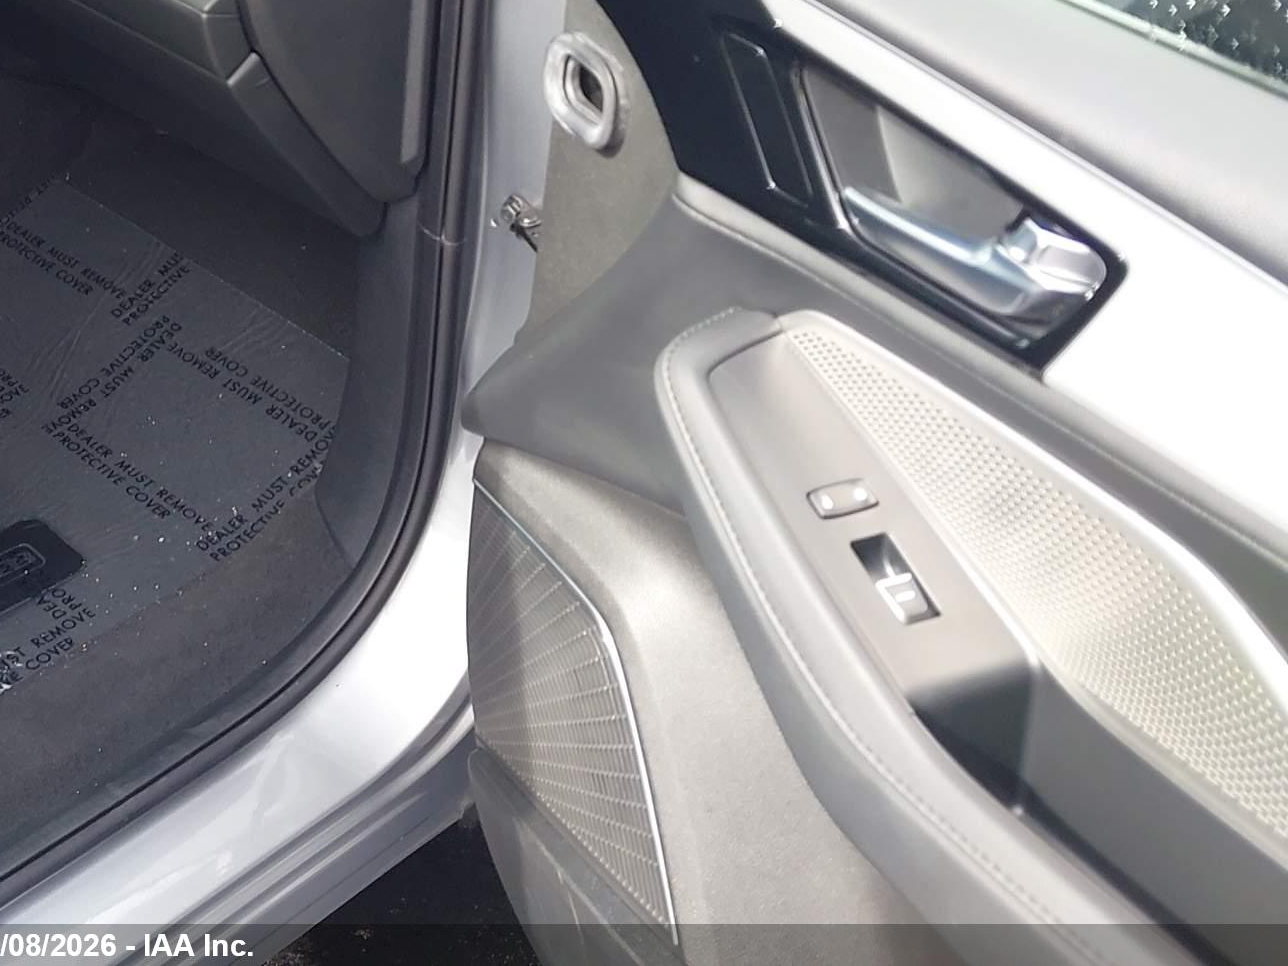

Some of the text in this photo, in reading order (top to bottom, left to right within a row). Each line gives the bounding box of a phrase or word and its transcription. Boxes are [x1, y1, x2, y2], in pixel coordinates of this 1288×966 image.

[47, 247, 80, 269] MUST
[80, 268, 127, 299] REMOVE
[55, 269, 94, 296] COVER
[111, 278, 154, 318] DEALER
[122, 264, 191, 326] PROTECTIVE
[41, 322, 182, 435] DEALER MUST REMOVE
[56, 315, 171, 410] PROTECTIVE COVER
[167, 341, 318, 443] DEALER MUST REMOVE
[205, 346, 332, 432] PROTECTIVE COVER
[52, 432, 171, 520] PROTECTIVE COVER
[68, 423, 215, 532] DEALER MUST REMOVE
[196, 514, 248, 551] DEALER
[251, 476, 288, 512] MUST
[209, 499, 285, 562] PROTECTIVE
[25, 637, 73, 671] COVER
[30, 608, 96, 649] REMOVE
